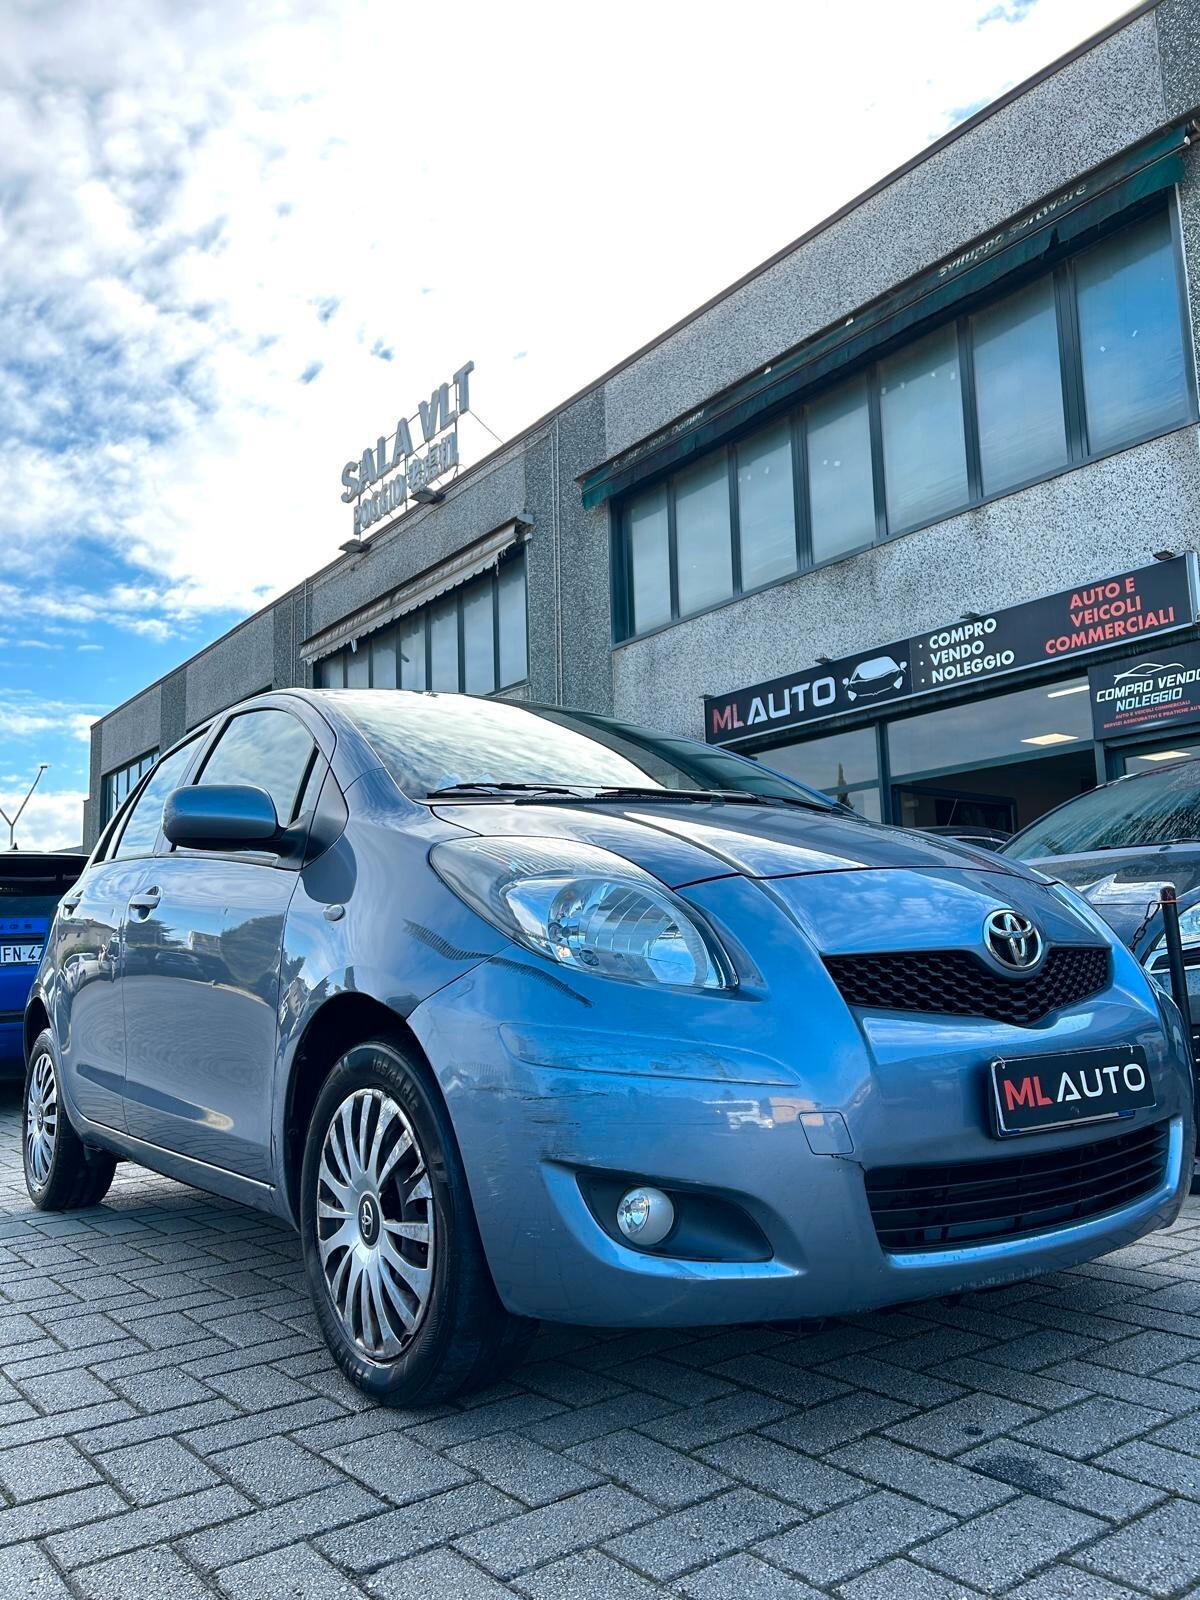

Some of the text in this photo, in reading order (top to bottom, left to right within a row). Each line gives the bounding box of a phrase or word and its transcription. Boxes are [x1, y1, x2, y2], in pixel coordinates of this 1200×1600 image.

[341, 360, 474, 503] SALA VLT
[1070, 577, 1135, 610] AUTO E
[1070, 596, 1141, 628] VEICOLI
[929, 618, 997, 649] COMPRO
[1045, 607, 1175, 654] COMMERCIALI
[930, 640, 985, 666] VENDO
[932, 650, 1015, 684] NOLEGGIO
[712, 676, 836, 734] ML AUTO
[1096, 680, 1153, 703] COMPRO
[1116, 687, 1183, 712] NOLEGGIO
[1154, 700, 1191, 711] COMMERCIALI
[3, 947, 21, 962] FN
[1004, 1063, 1145, 1111] ML AUTO
